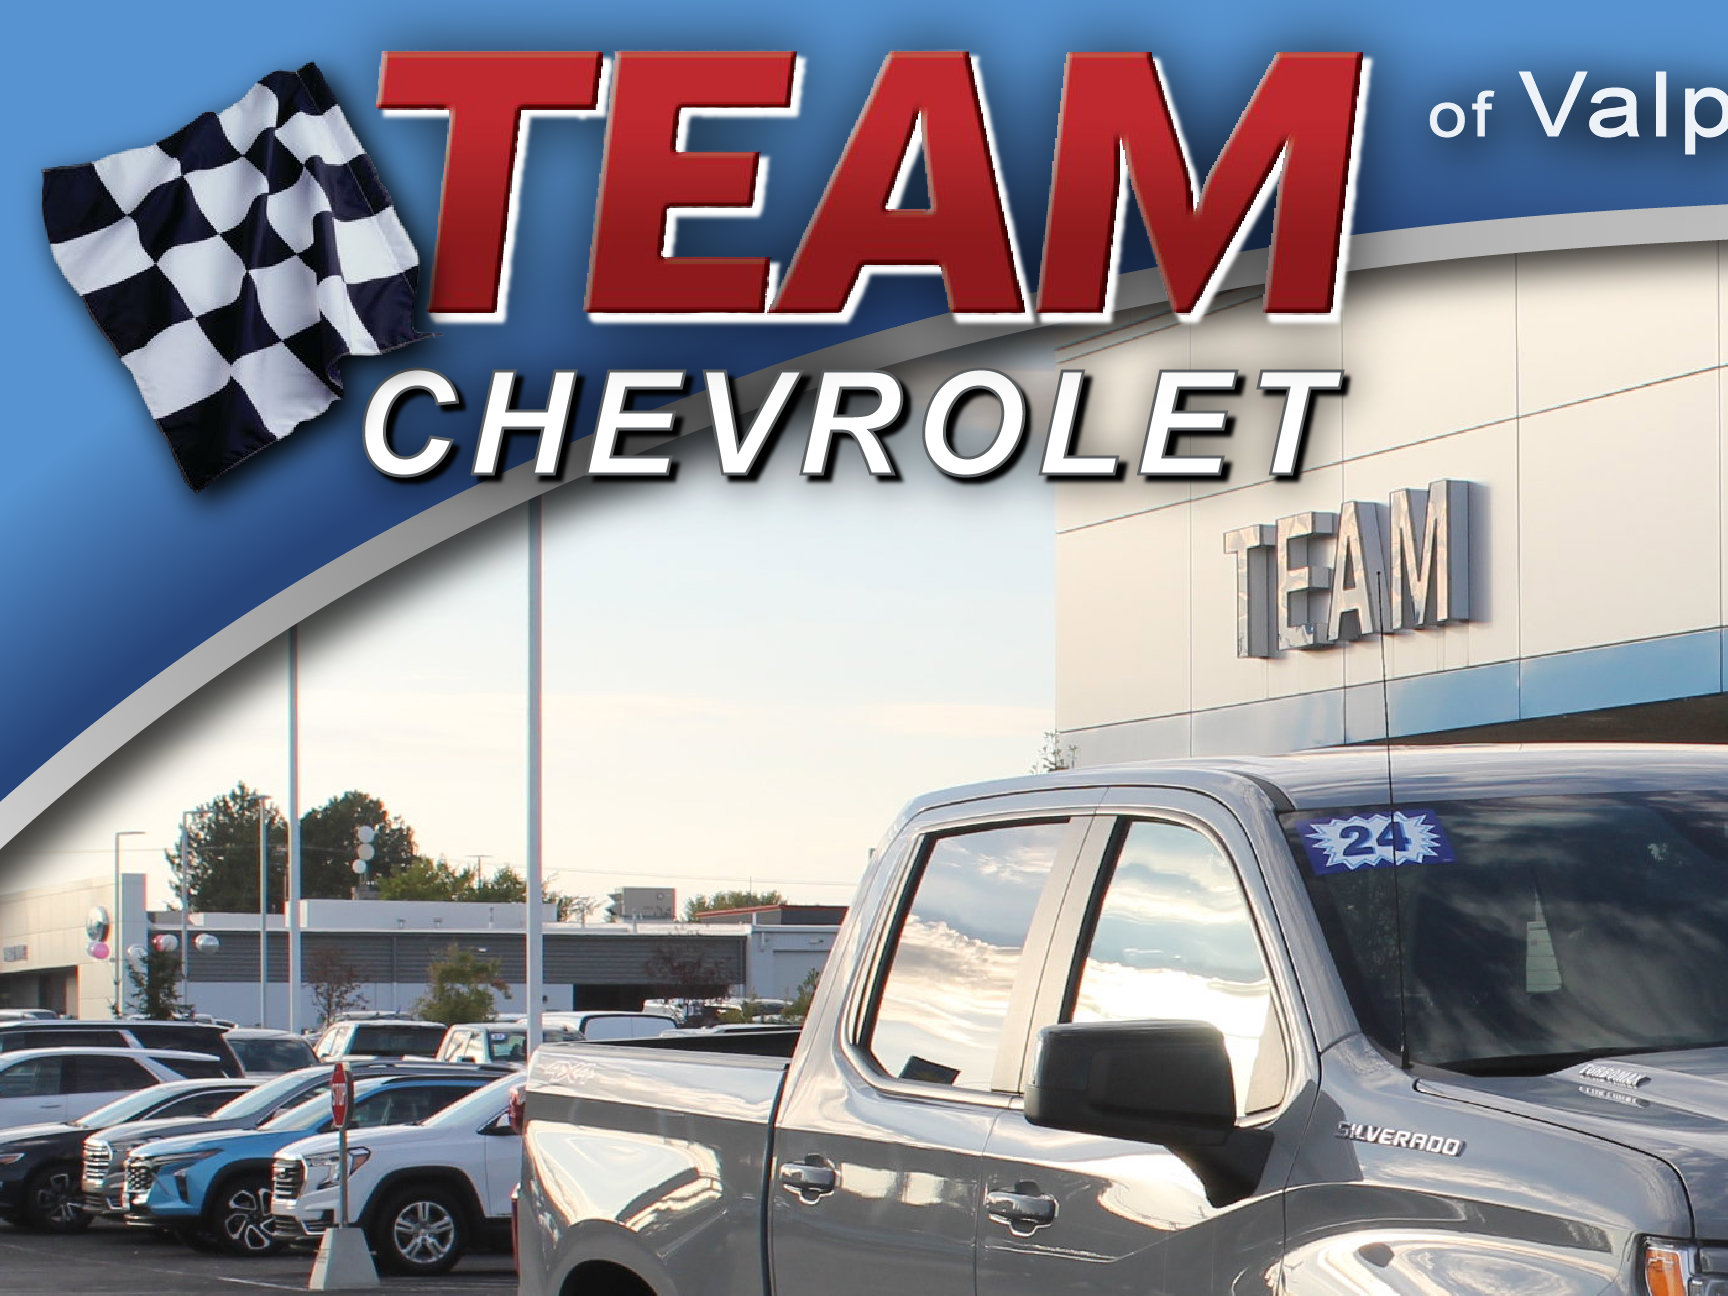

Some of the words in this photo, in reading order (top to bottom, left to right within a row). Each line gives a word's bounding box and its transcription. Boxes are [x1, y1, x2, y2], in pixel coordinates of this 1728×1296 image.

[1223, 480, 1470, 658] TEAM
[1339, 821, 1412, 856] 24
[1336, 1120, 1467, 1157] SILVERADO
